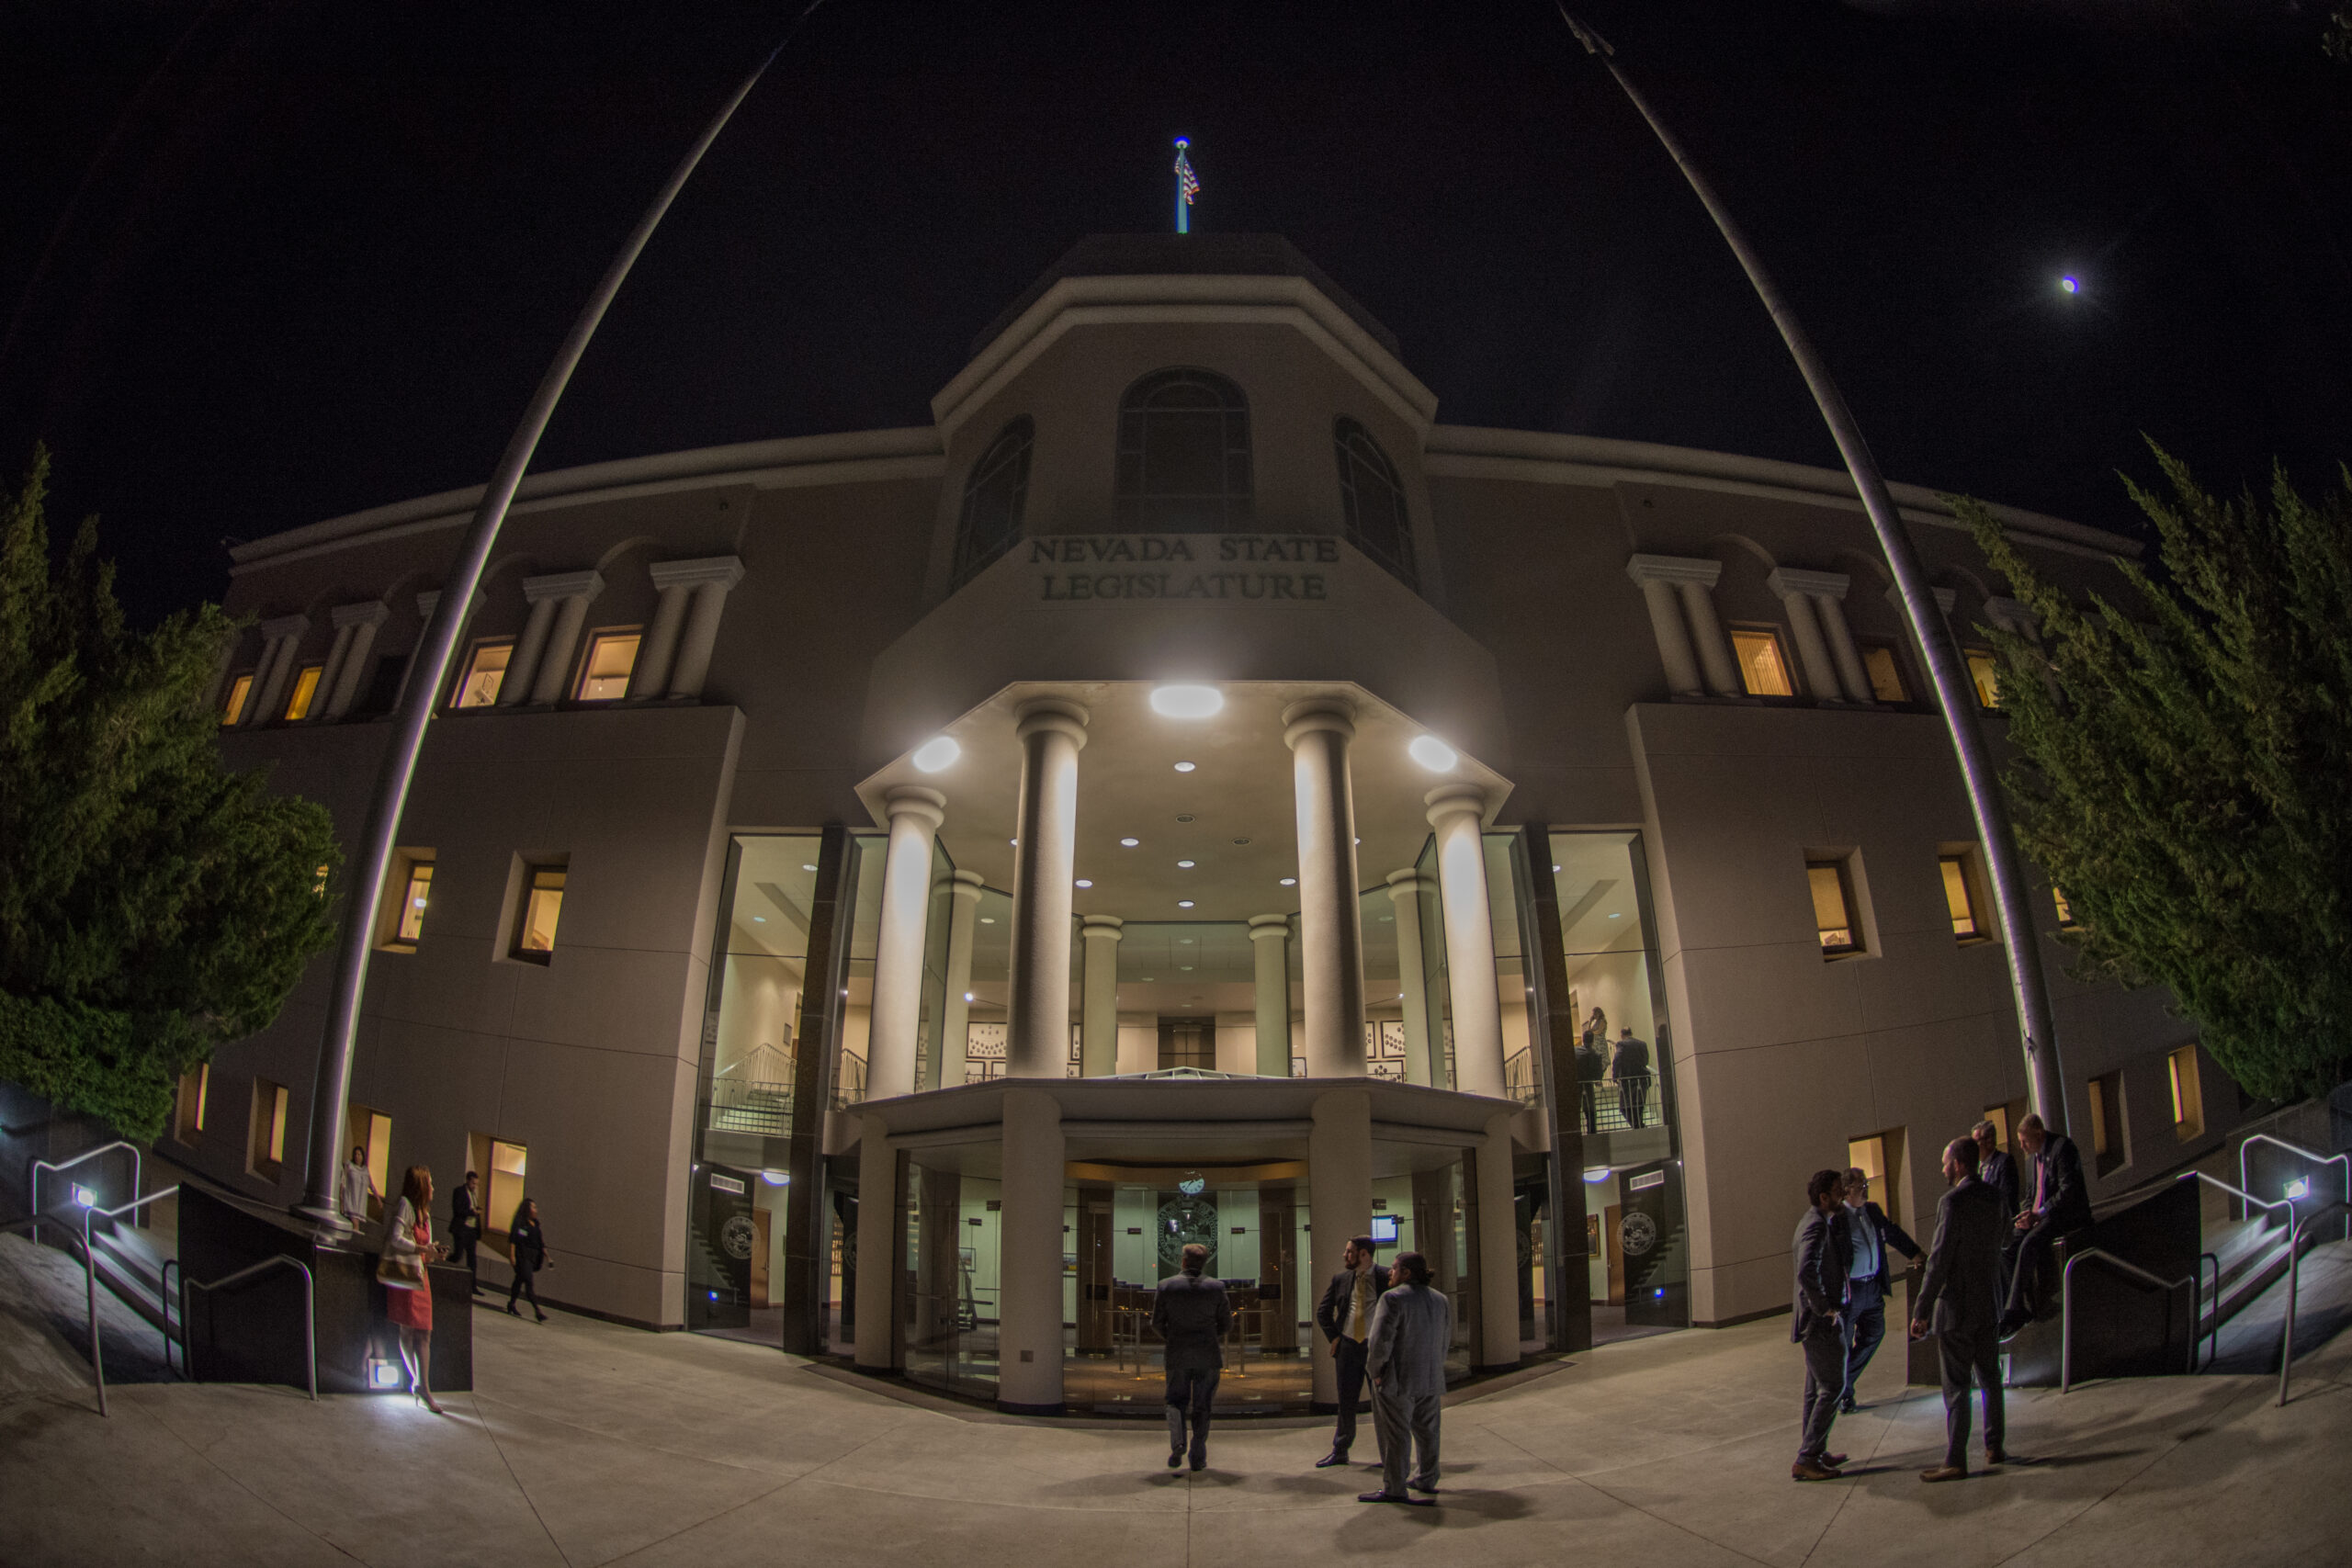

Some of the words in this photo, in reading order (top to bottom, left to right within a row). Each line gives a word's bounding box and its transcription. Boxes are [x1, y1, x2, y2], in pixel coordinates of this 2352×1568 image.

[1029, 537, 1194, 562] NEVADA
[1219, 536, 1340, 562] STATE
[1042, 573, 1328, 600] LEGISLATURE
